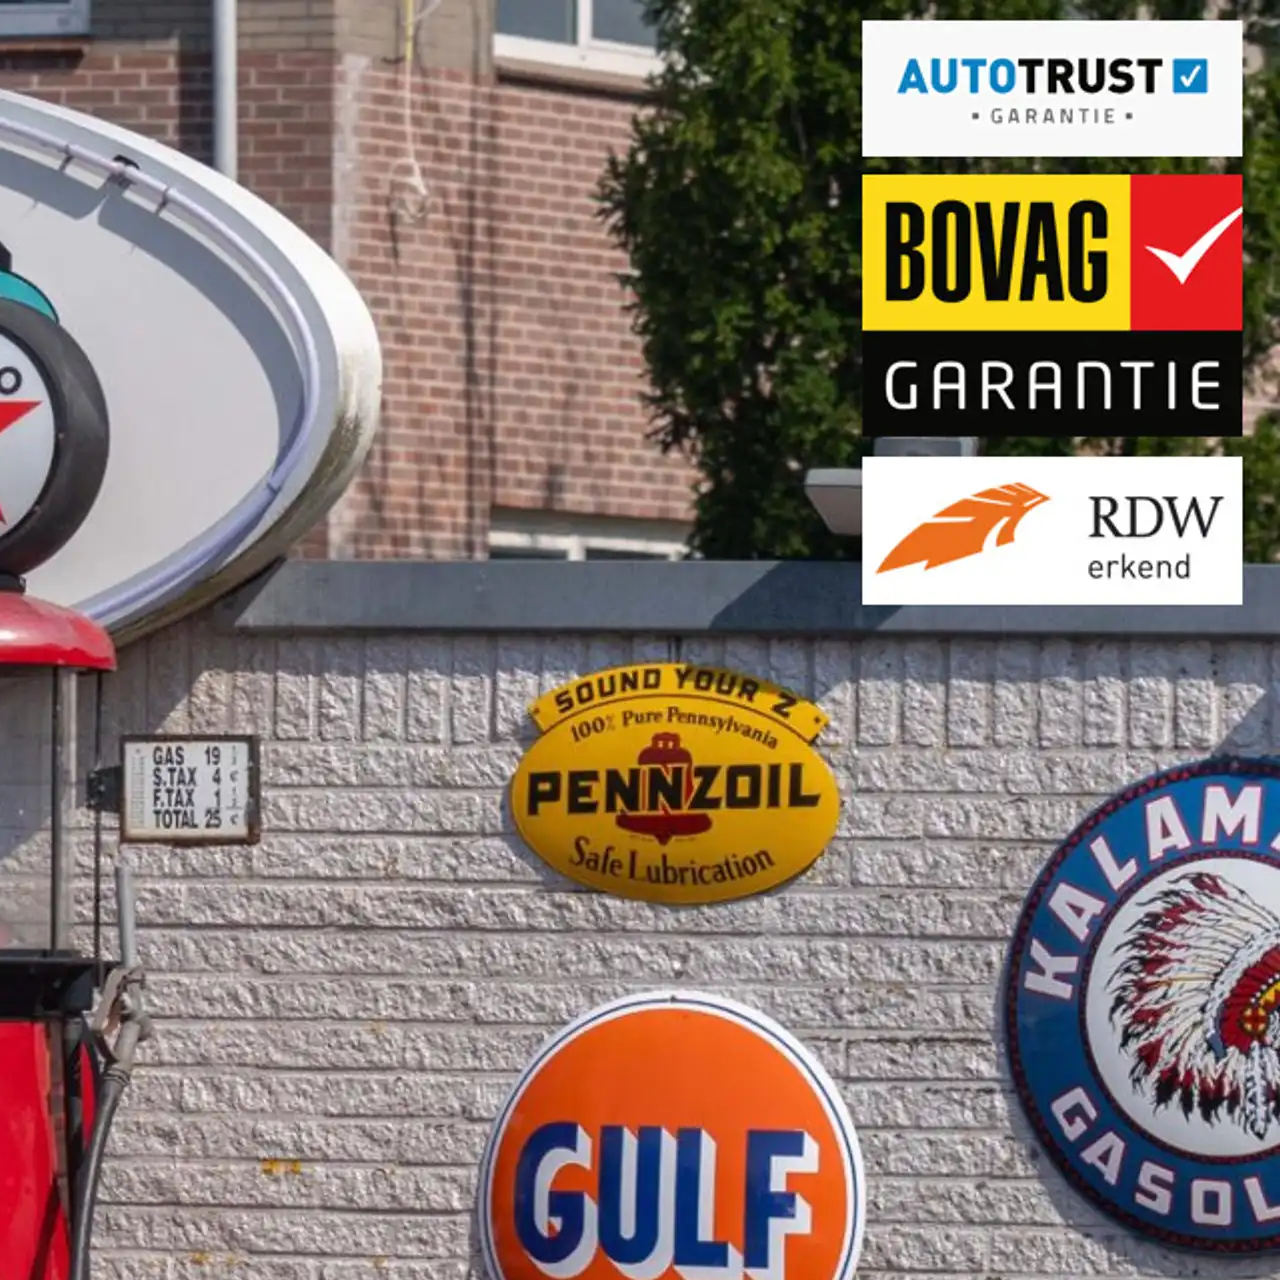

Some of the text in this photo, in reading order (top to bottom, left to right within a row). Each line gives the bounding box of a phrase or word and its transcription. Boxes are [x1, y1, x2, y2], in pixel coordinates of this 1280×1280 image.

[555, 667, 662, 714] SOUND
[674, 666, 759, 701] YOUR
[622, 710, 664, 728] Pure
[667, 706, 779, 750] Pennsylvania
[152, 746, 185, 766] GAS
[205, 746, 221, 766] 19
[152, 767, 197, 787] S.TAX
[212, 768, 221, 786] 4
[152, 788, 195, 807] F.TAX
[527, 762, 822, 817] PENNZOIL
[152, 809, 199, 829] TOTAL
[205, 809, 222, 829] 25
[569, 835, 775, 886] Safe Lubrication
[1024, 785, 1280, 1001] KALAM
[1050, 1086, 1280, 1229] GASOL
